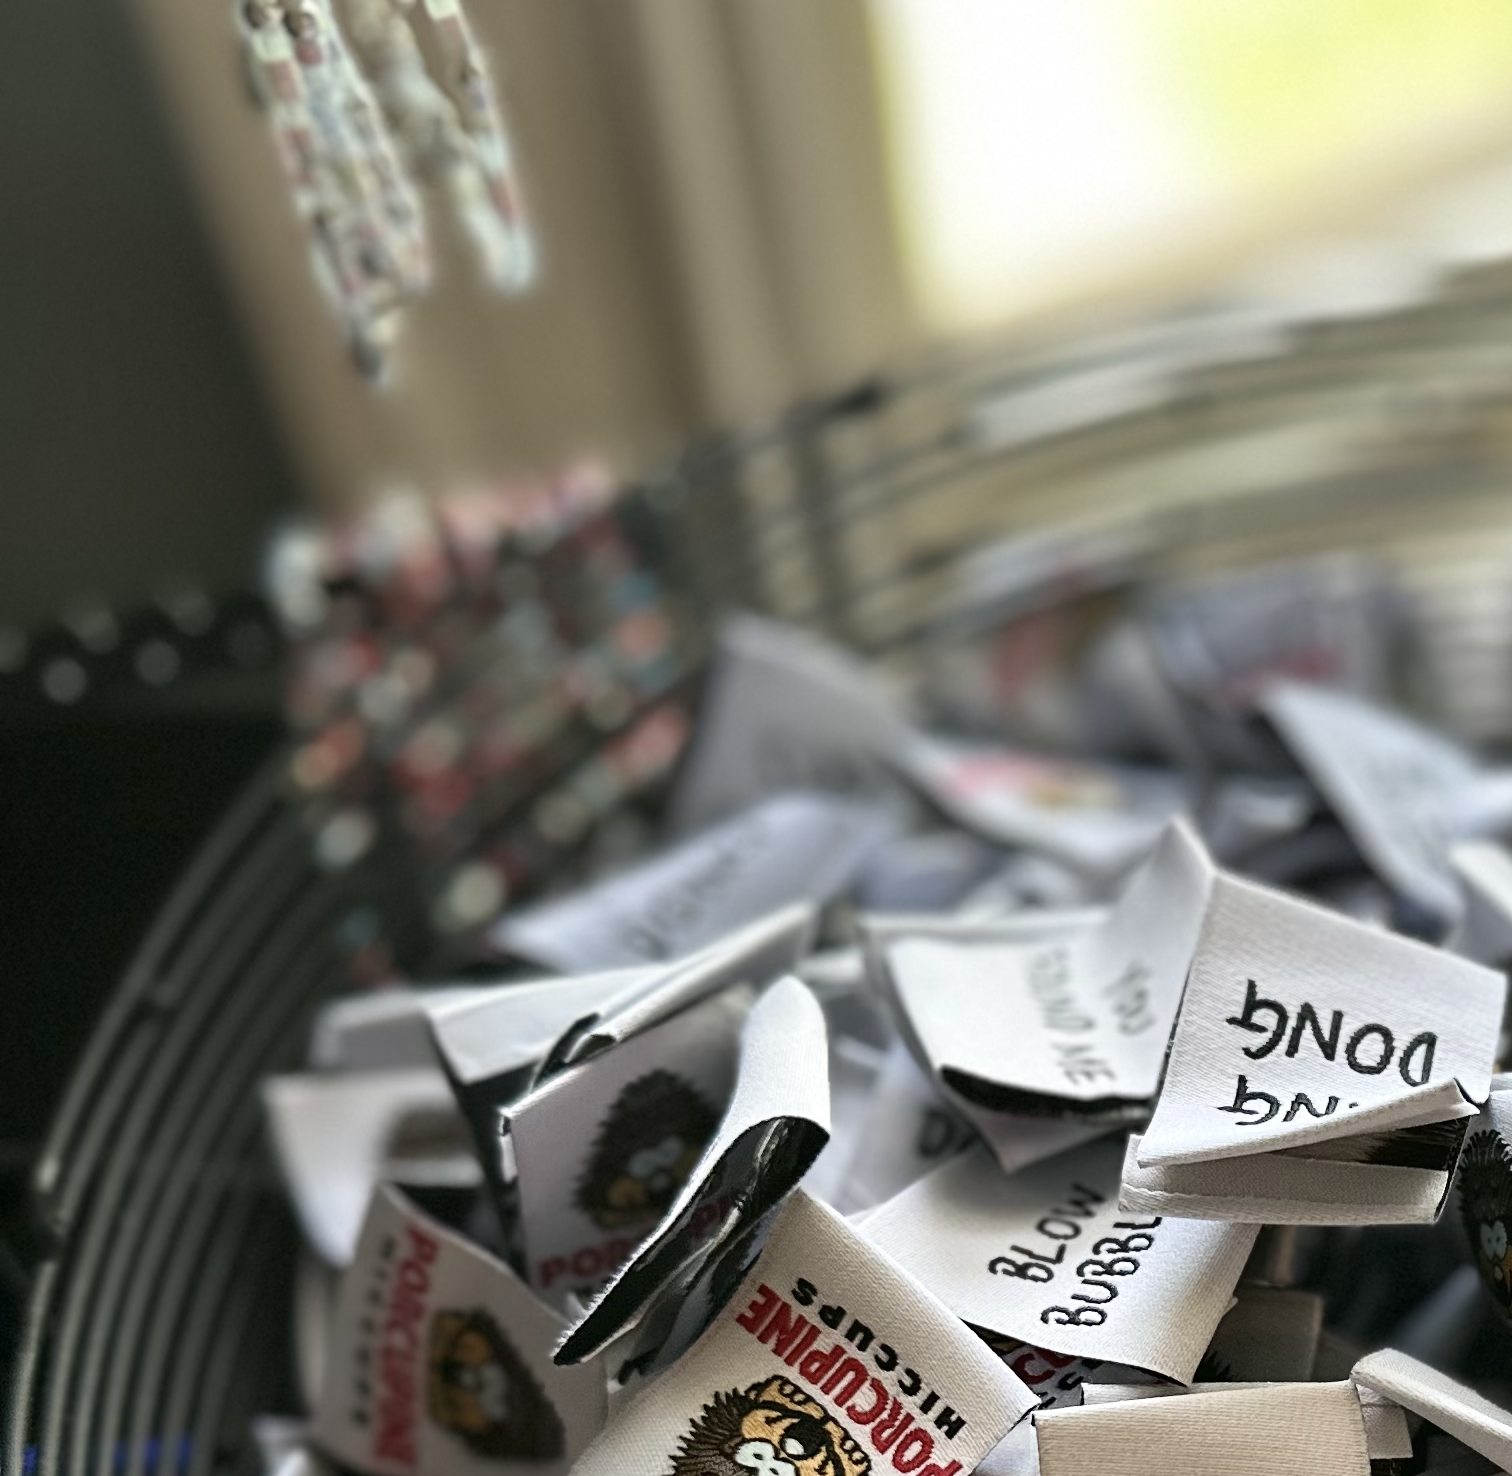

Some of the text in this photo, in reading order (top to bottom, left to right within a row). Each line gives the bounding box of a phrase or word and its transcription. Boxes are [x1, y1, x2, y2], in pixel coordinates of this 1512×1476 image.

[1227, 979, 1437, 1087] DONG
[1217, 1075, 1361, 1126] NG
[987, 1183, 1106, 1286] BLOW
[1040, 1212, 1164, 1329] BUBBL
[790, 1276, 966, 1442] HICCUPS
